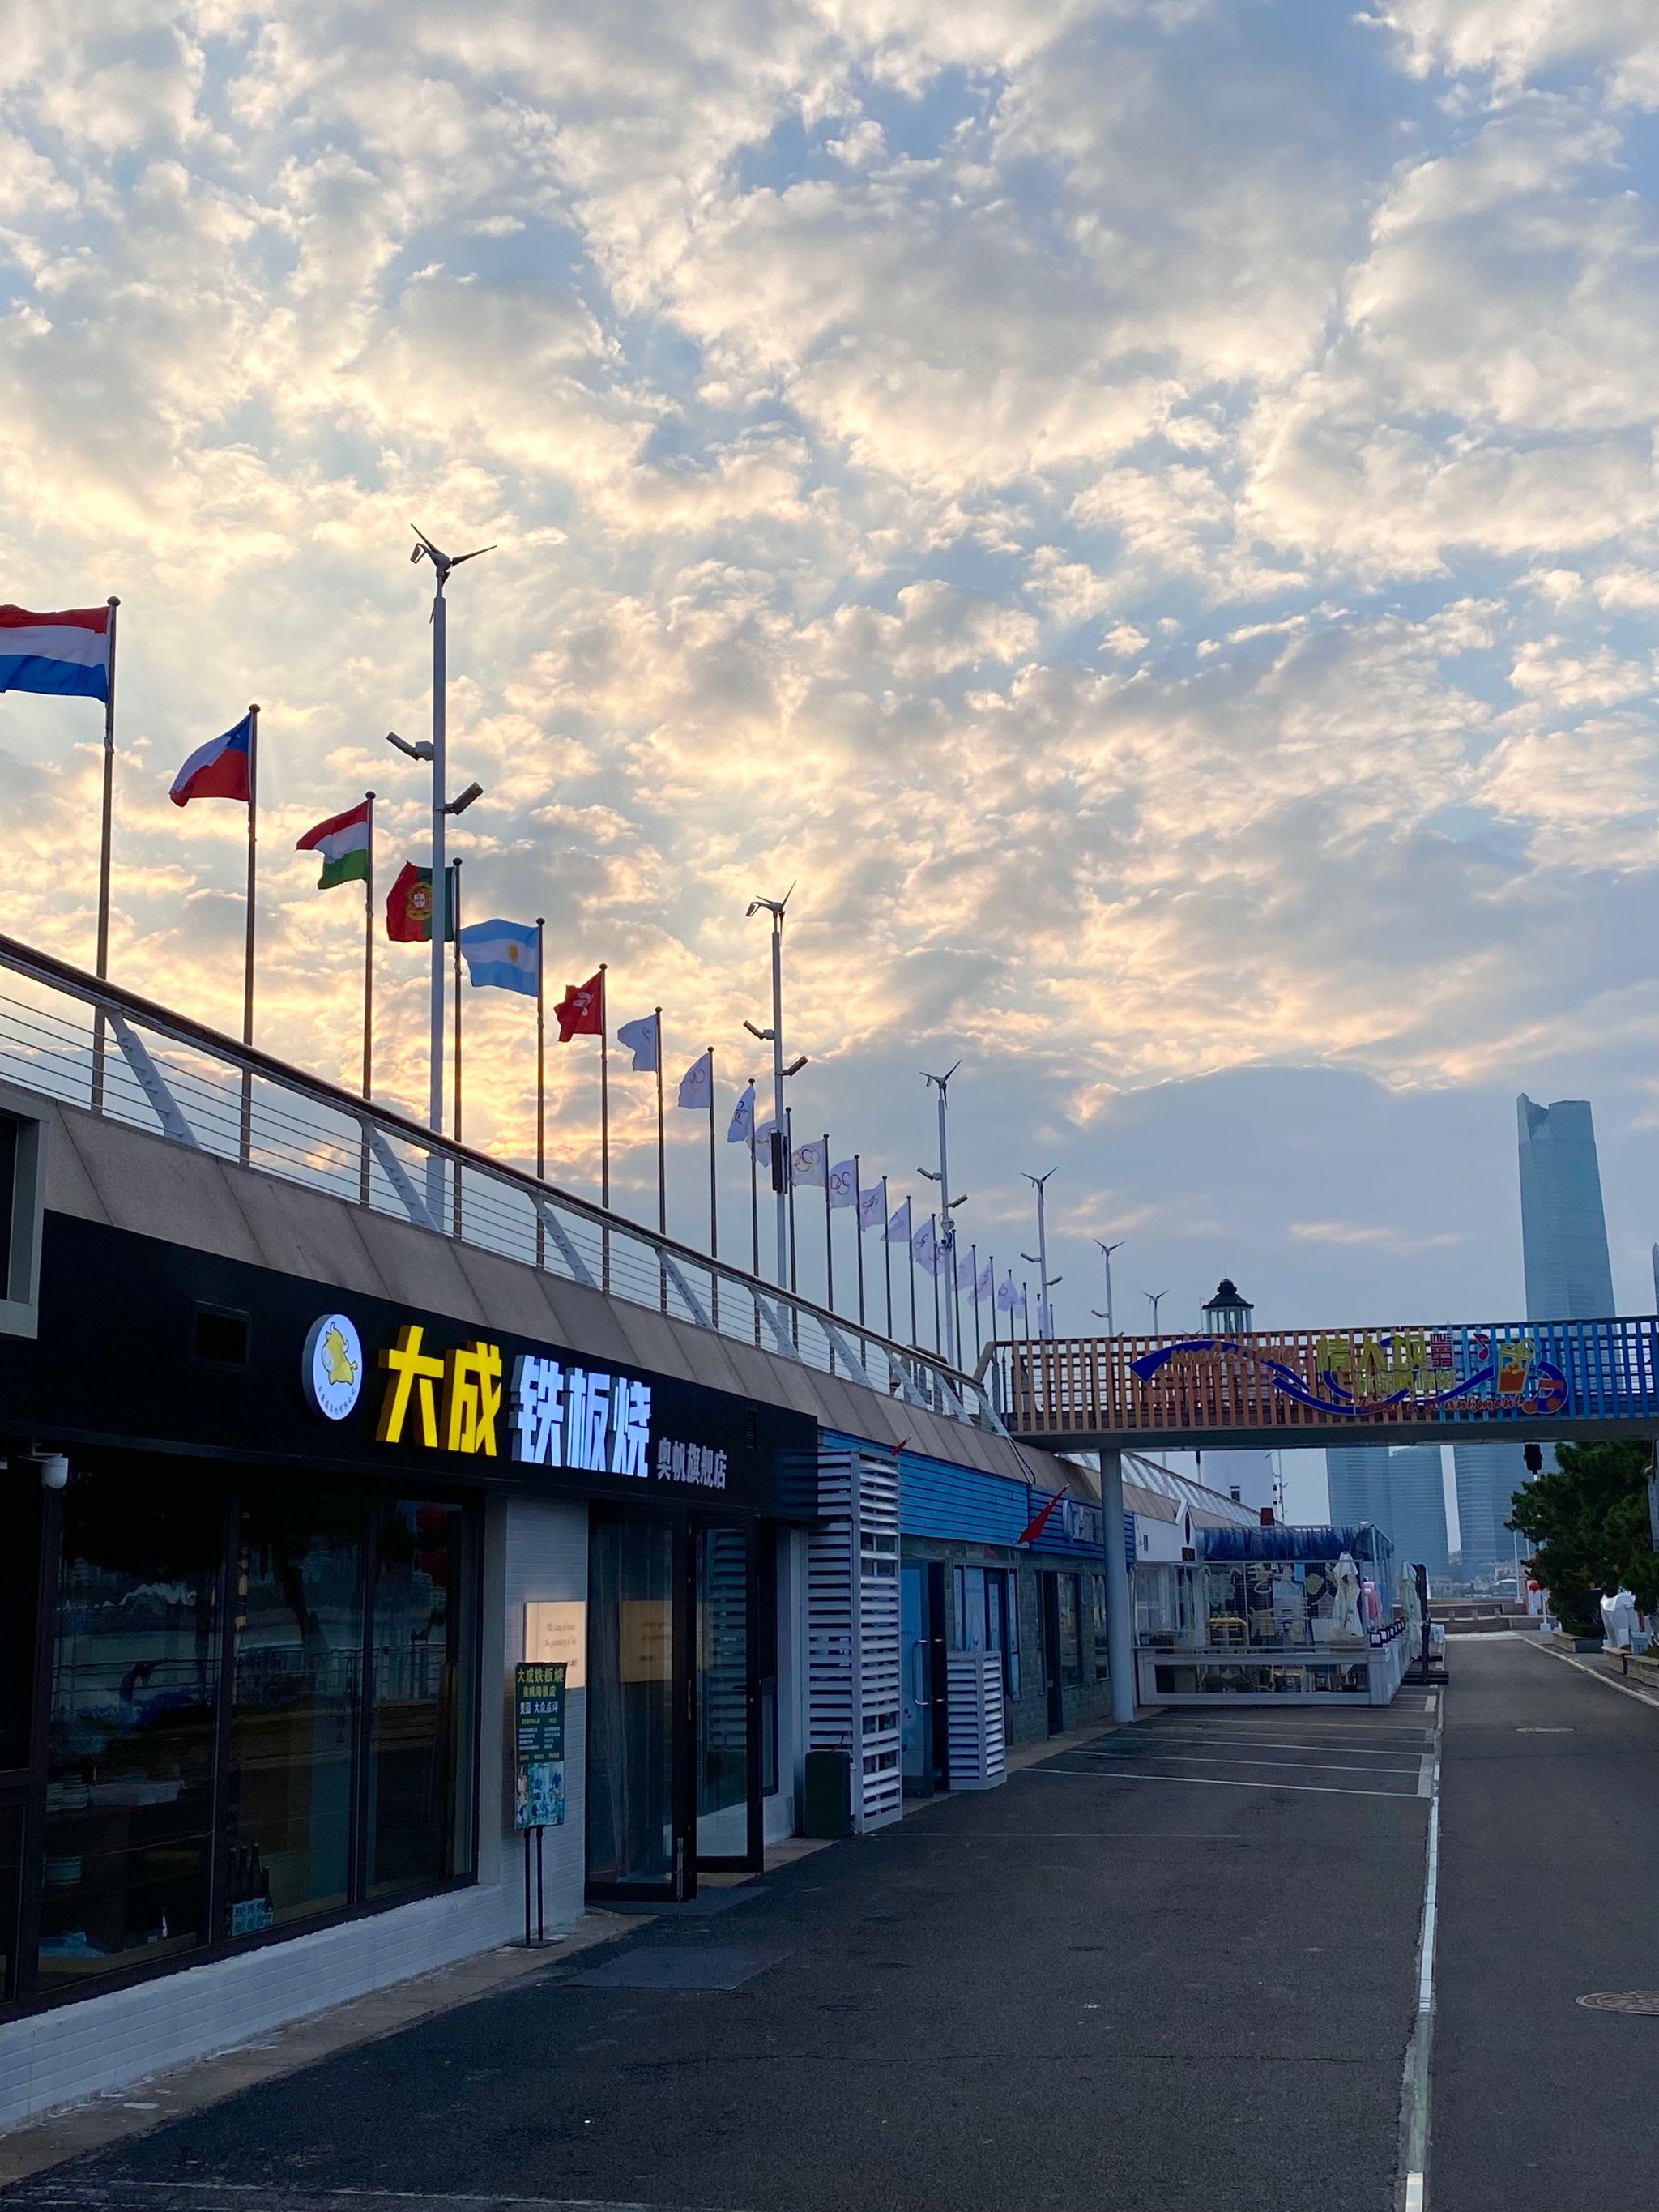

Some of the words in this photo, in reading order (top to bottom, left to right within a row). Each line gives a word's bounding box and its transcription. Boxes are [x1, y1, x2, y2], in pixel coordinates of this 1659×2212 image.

[1171, 1343, 1296, 1368] welcome
[1316, 1334, 1426, 1373] 情人坝
[376, 1325, 651, 1478] 大成铁板烧
[656, 1437, 727, 1489] 奥帆旗舰店
